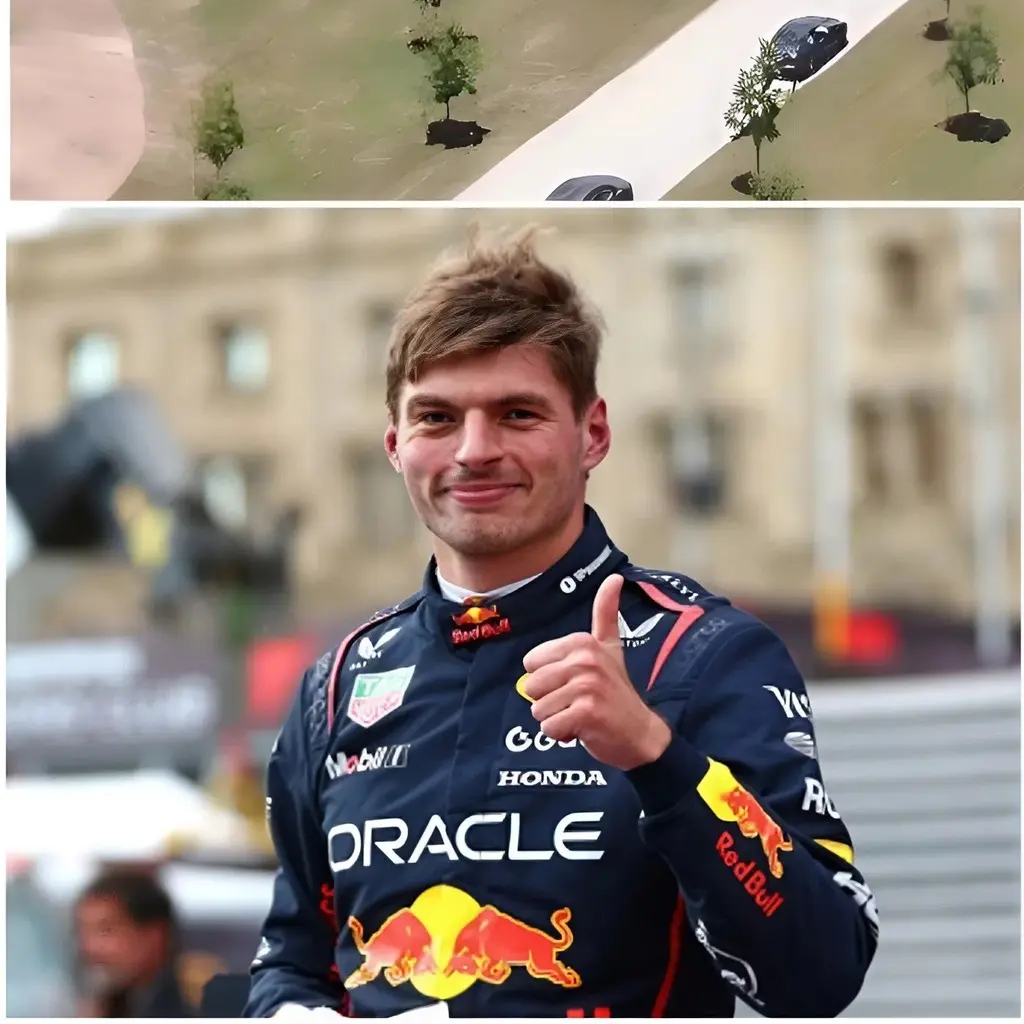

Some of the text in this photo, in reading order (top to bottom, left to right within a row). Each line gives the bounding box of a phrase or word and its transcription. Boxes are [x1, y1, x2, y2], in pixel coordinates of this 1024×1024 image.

[497, 770, 608, 787] HONDA
[328, 812, 604, 872] ORACLE
[715, 830, 757, 882] Red
[743, 869, 785, 918] Bull
